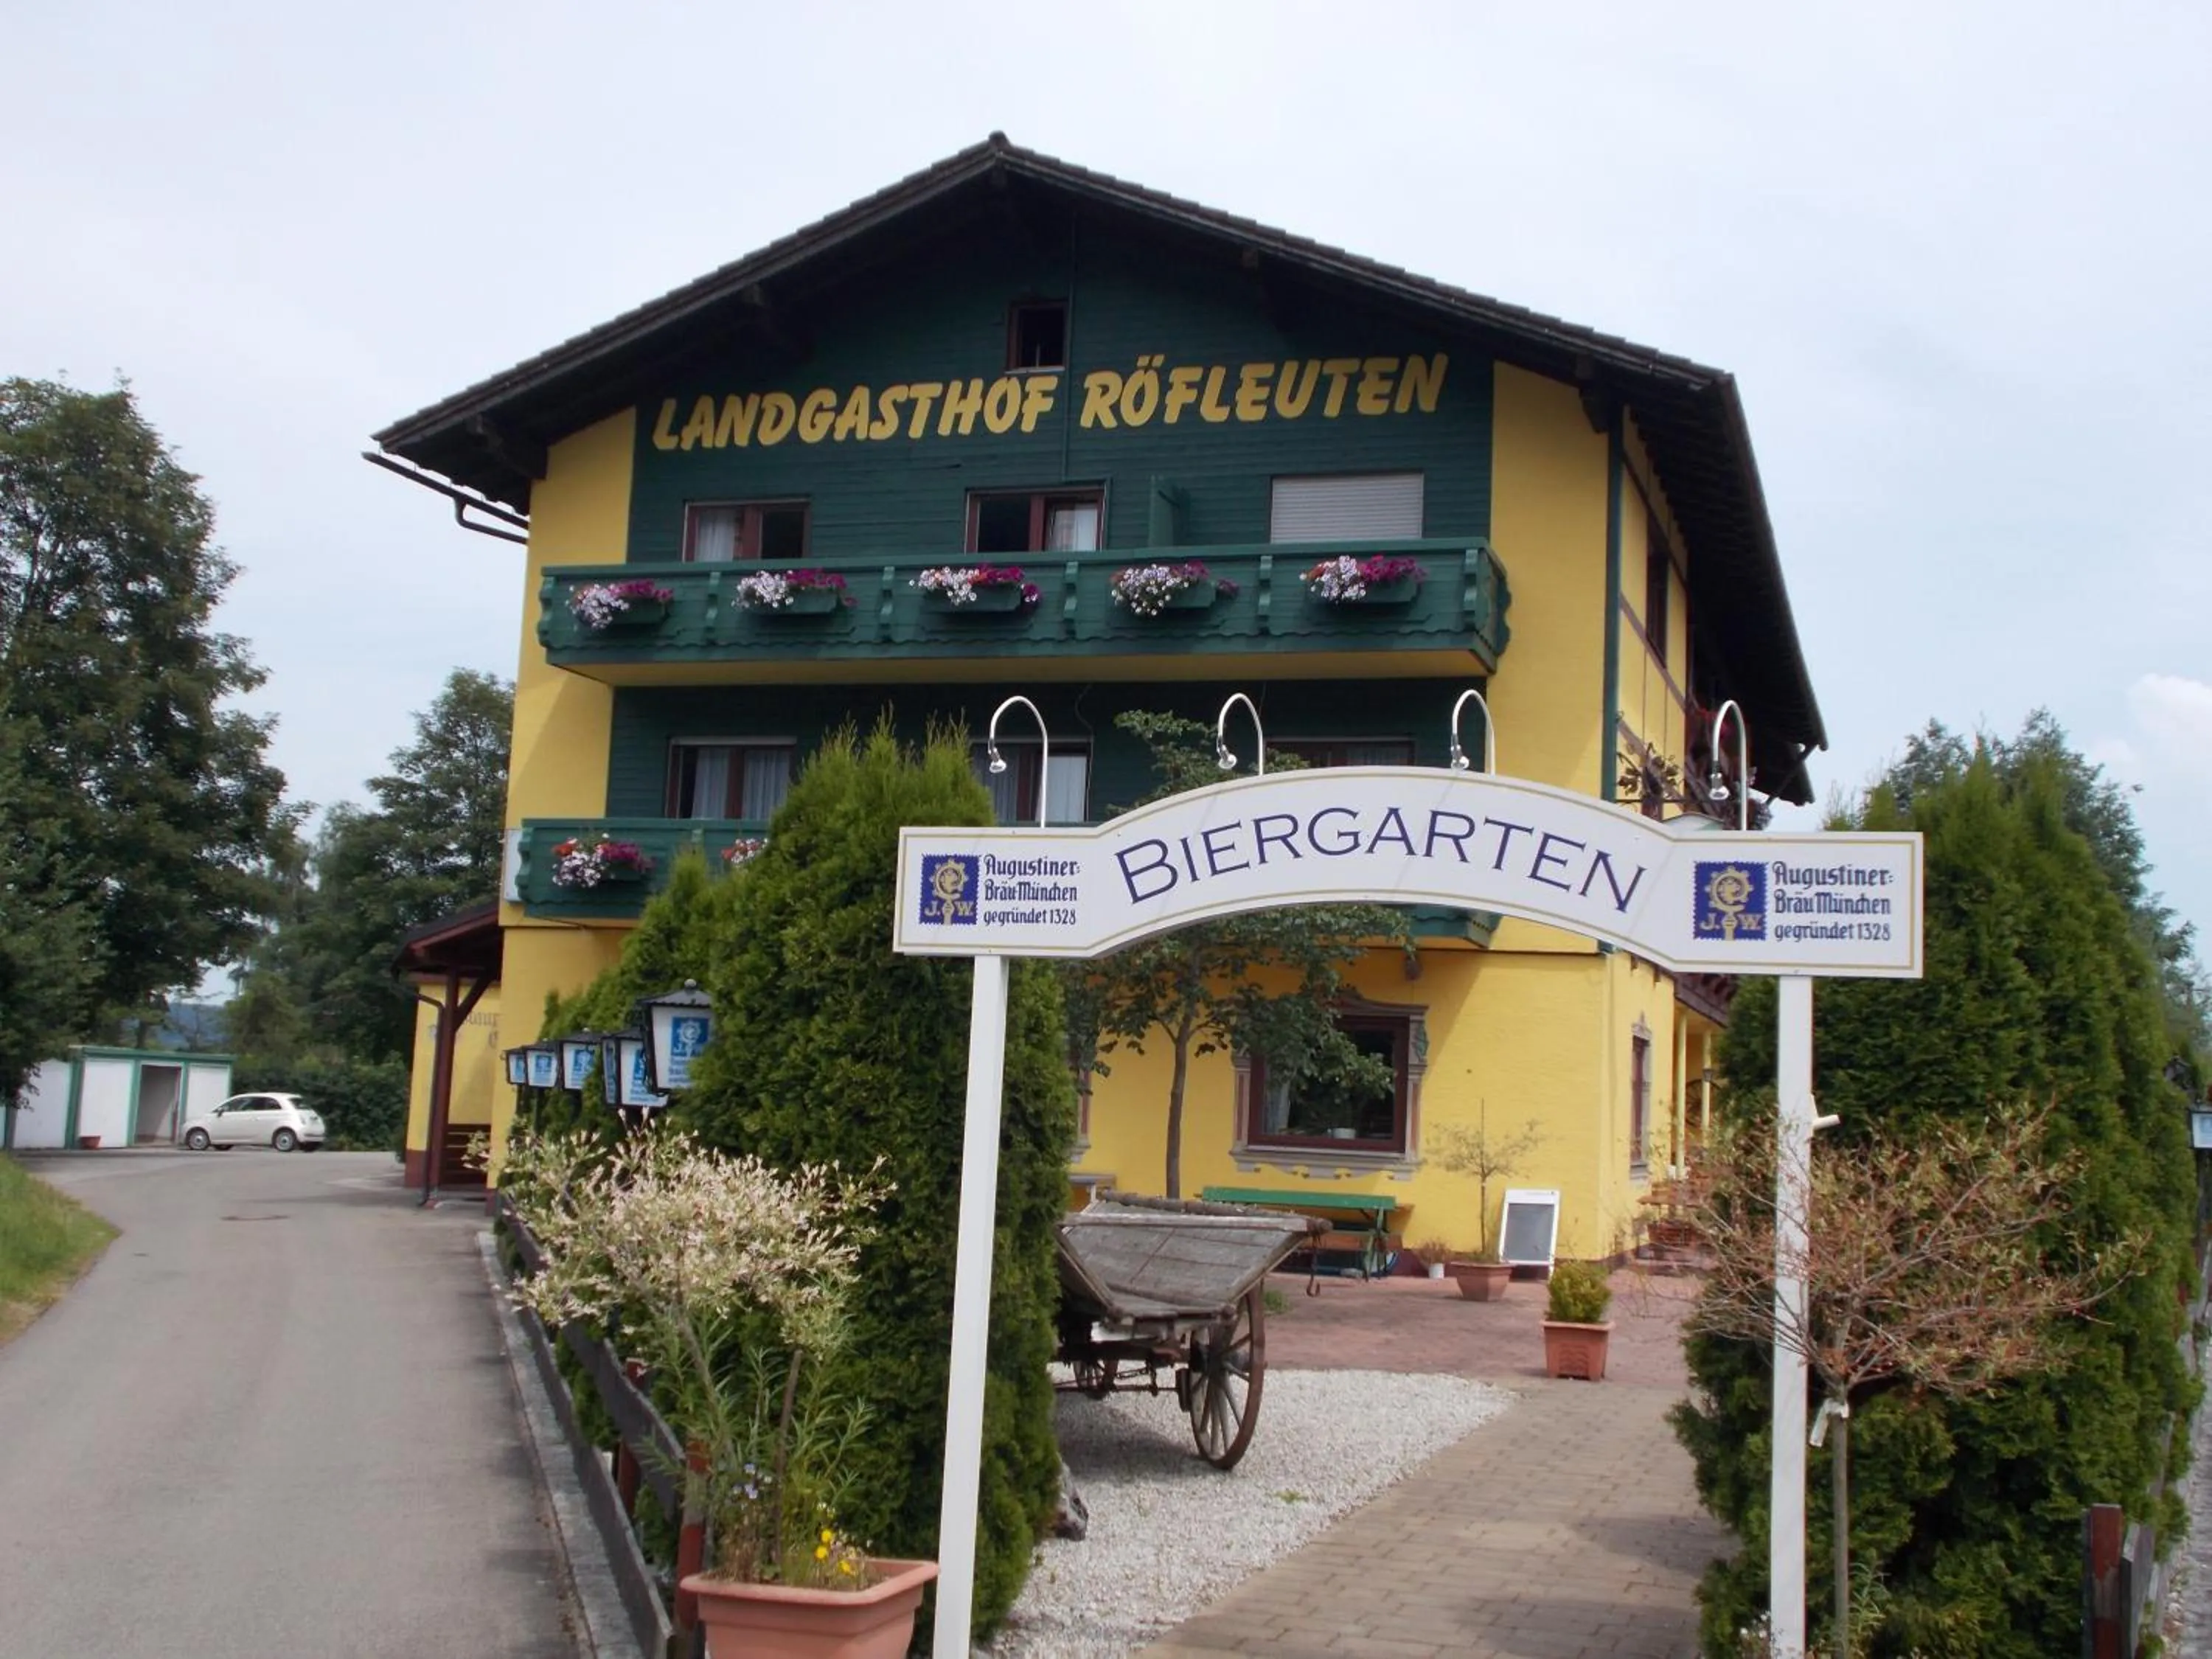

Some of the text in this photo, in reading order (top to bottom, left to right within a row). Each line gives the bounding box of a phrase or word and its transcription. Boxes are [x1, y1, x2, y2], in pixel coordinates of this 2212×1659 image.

[653, 354, 1449, 451] LANDGASTHOF RÖFLEUTEN
[1114, 807, 1647, 913] BIERGARTEN
[984, 907, 1077, 926] gegründet 1328
[1775, 921, 1891, 942] gegründet 1328
